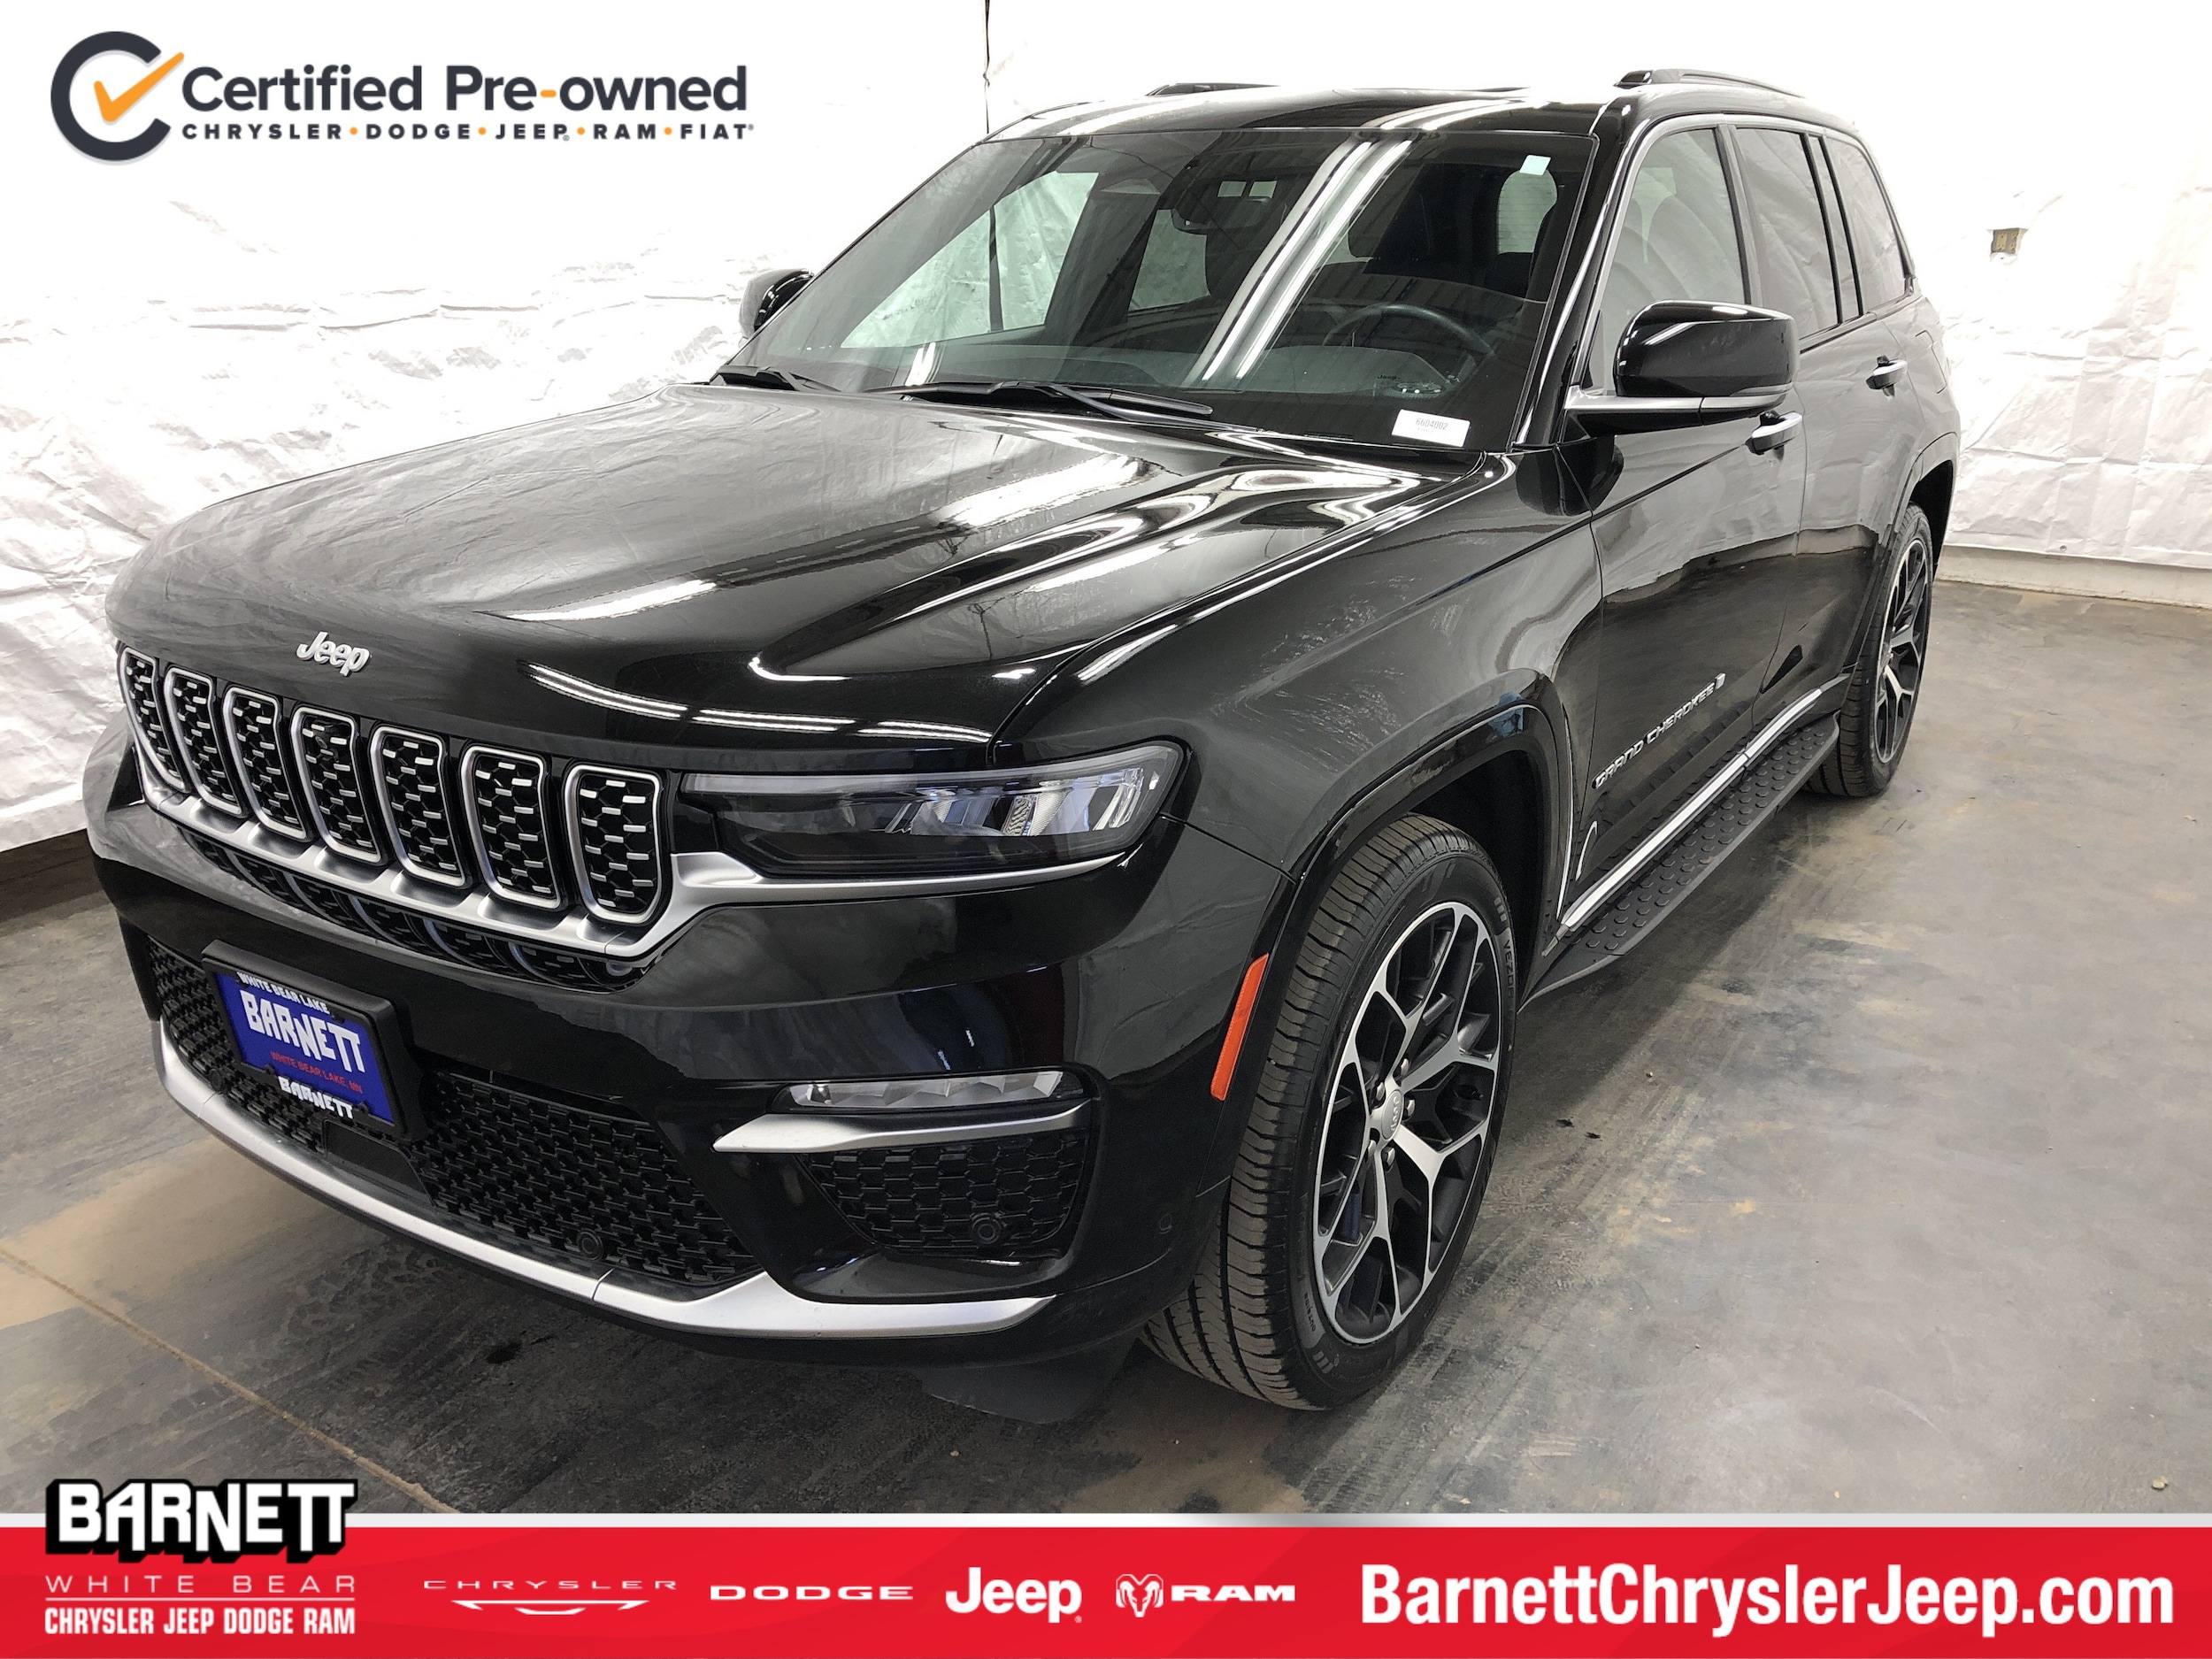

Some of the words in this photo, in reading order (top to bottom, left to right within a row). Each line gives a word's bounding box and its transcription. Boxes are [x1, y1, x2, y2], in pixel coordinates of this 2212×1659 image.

[1416, 417, 1449, 431] 6604002
[296, 631, 370, 677] Jeep
[1594, 740, 1644, 789] GRAND
[1646, 682, 1716, 745] CHEROKEE
[236, 972, 273, 994] WHITE
[269, 983, 299, 1003] BEAR
[300, 994, 331, 1015] LAKE
[240, 989, 365, 1073] BARNETT
[270, 1050, 298, 1069] WHITE
[296, 1060, 323, 1077] BEAR
[278, 1076, 354, 1120] BARNETT
